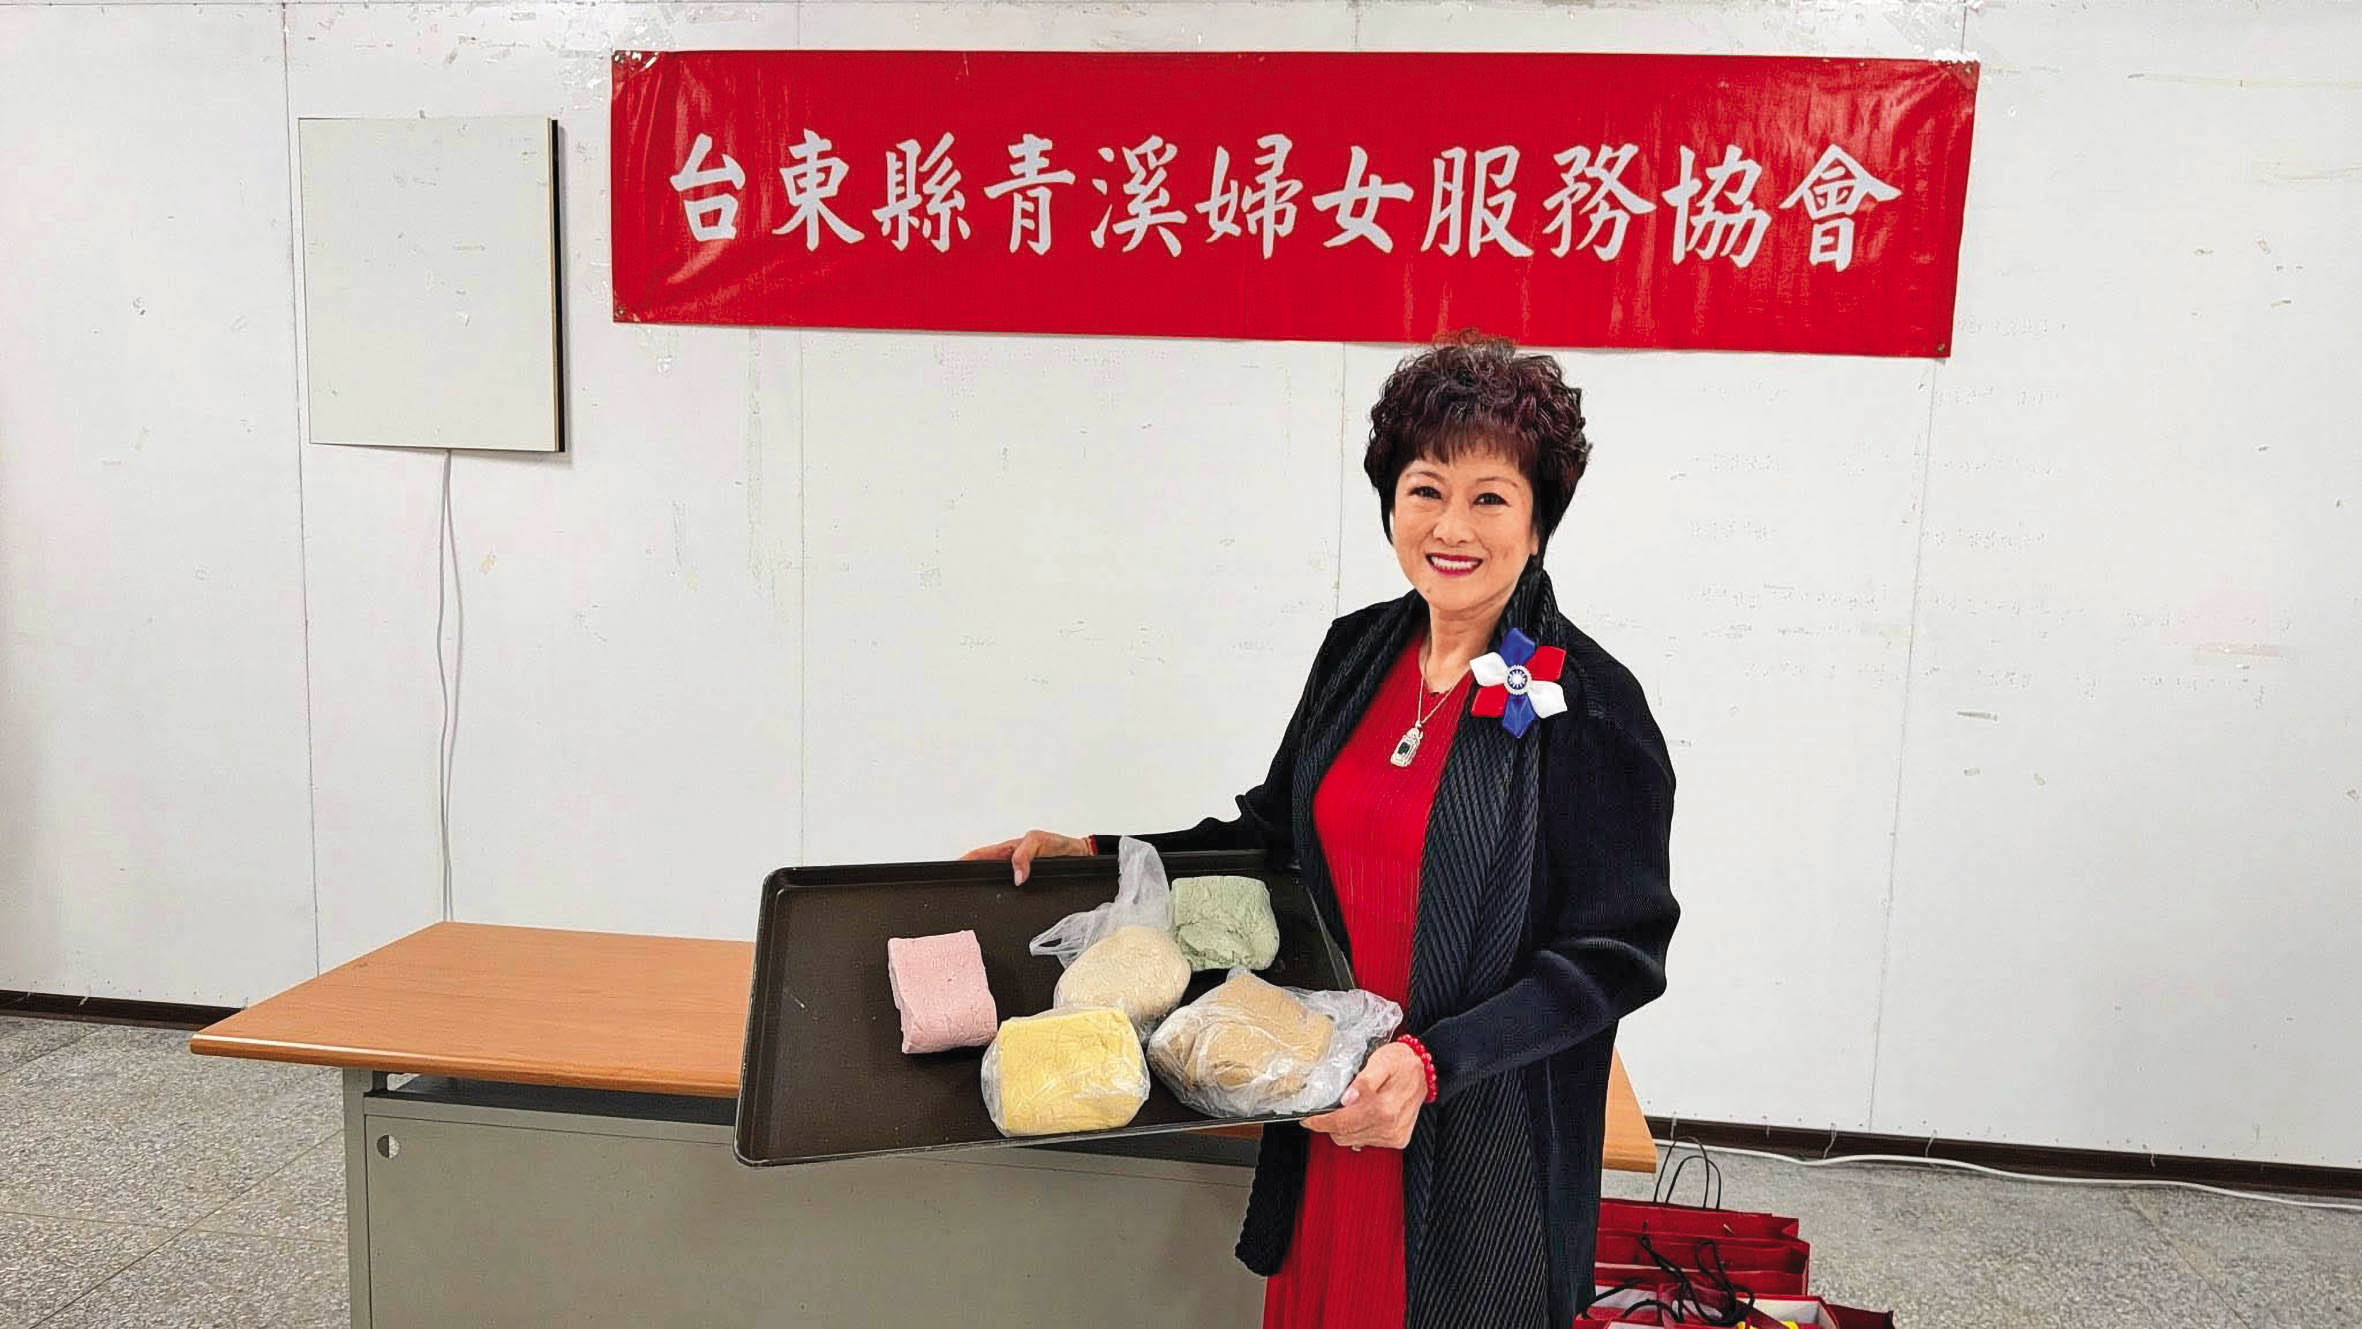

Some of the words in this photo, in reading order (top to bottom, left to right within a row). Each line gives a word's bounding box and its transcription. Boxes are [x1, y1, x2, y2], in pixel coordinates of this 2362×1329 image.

[669, 129, 1902, 272] 台東縣青溪婦女服務協會
